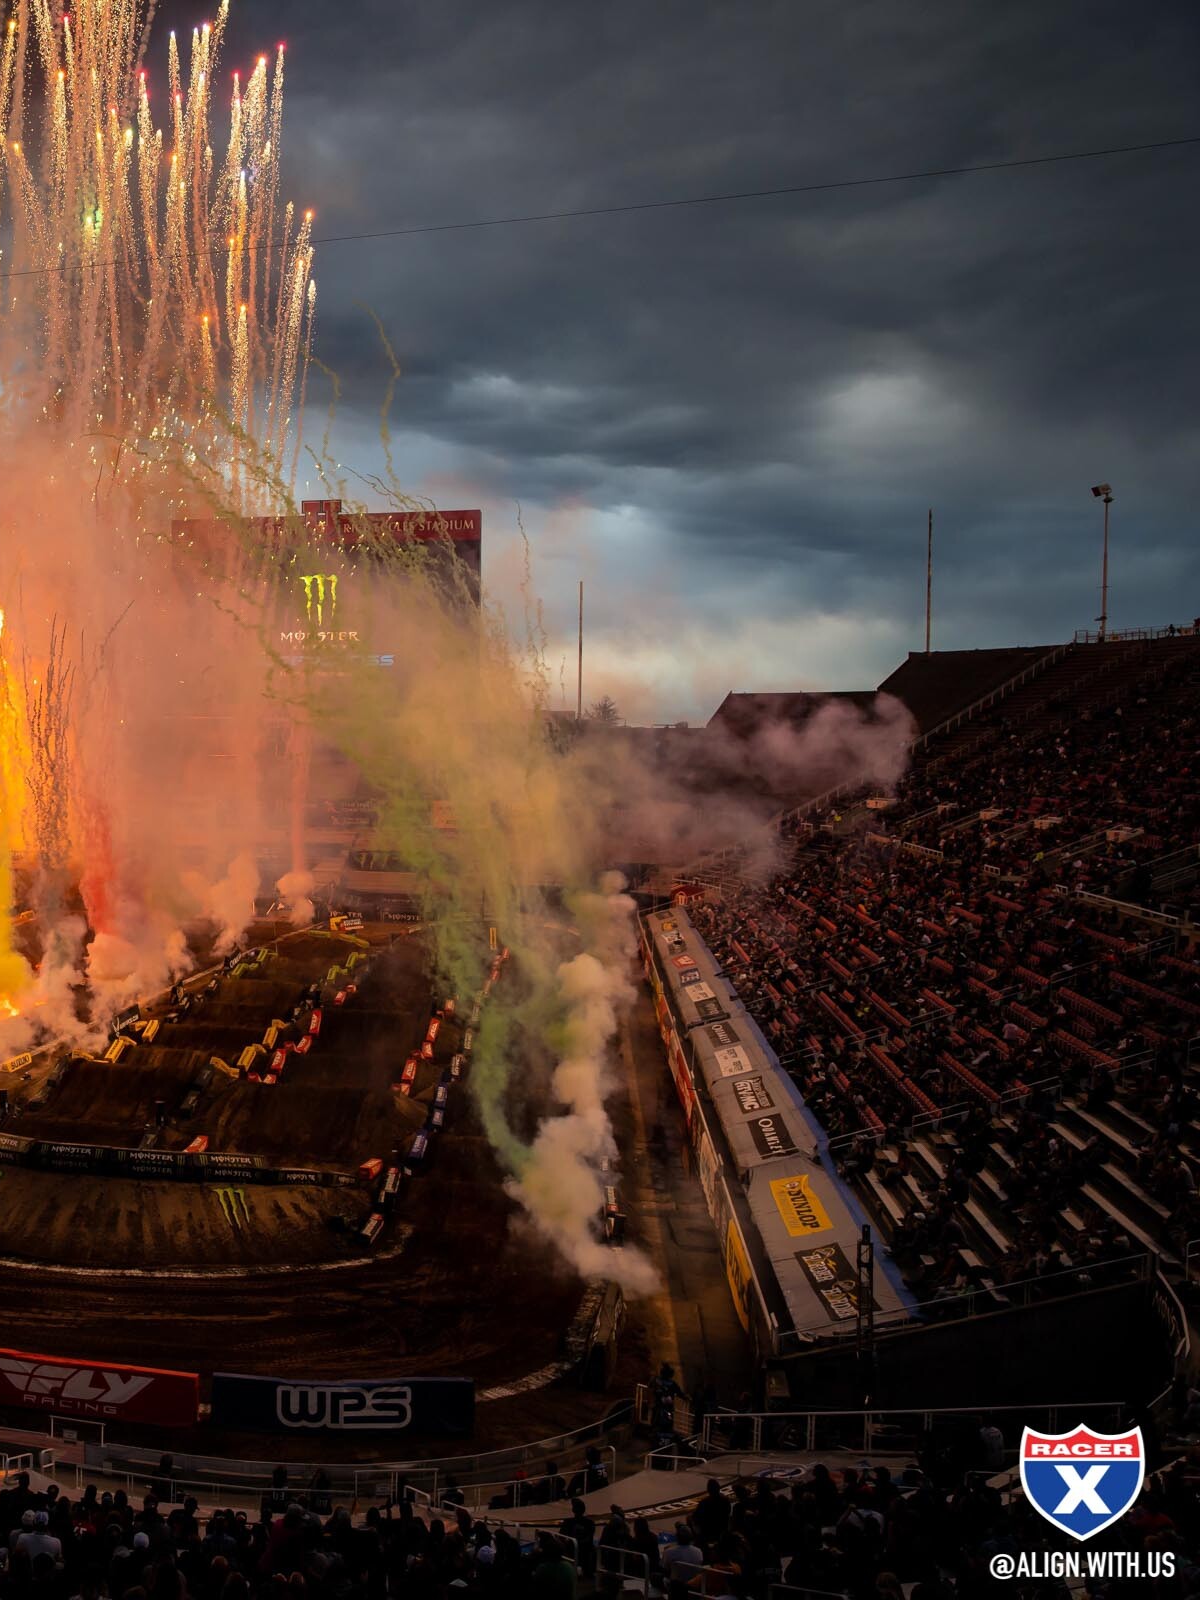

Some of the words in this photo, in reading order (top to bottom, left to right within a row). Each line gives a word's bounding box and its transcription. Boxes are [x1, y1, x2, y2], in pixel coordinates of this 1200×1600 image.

[419, 519, 474, 531] STADIUM
[280, 630, 360, 643] MOSTER
[51, 1144, 92, 1155] MONSTER
[129, 1150, 175, 1162] MONSTER
[211, 1155, 252, 1165] MONSTER
[787, 1188, 820, 1228] DUNLOP
[23, 1393, 118, 1416] RACING
[276, 1384, 413, 1430] WPS
